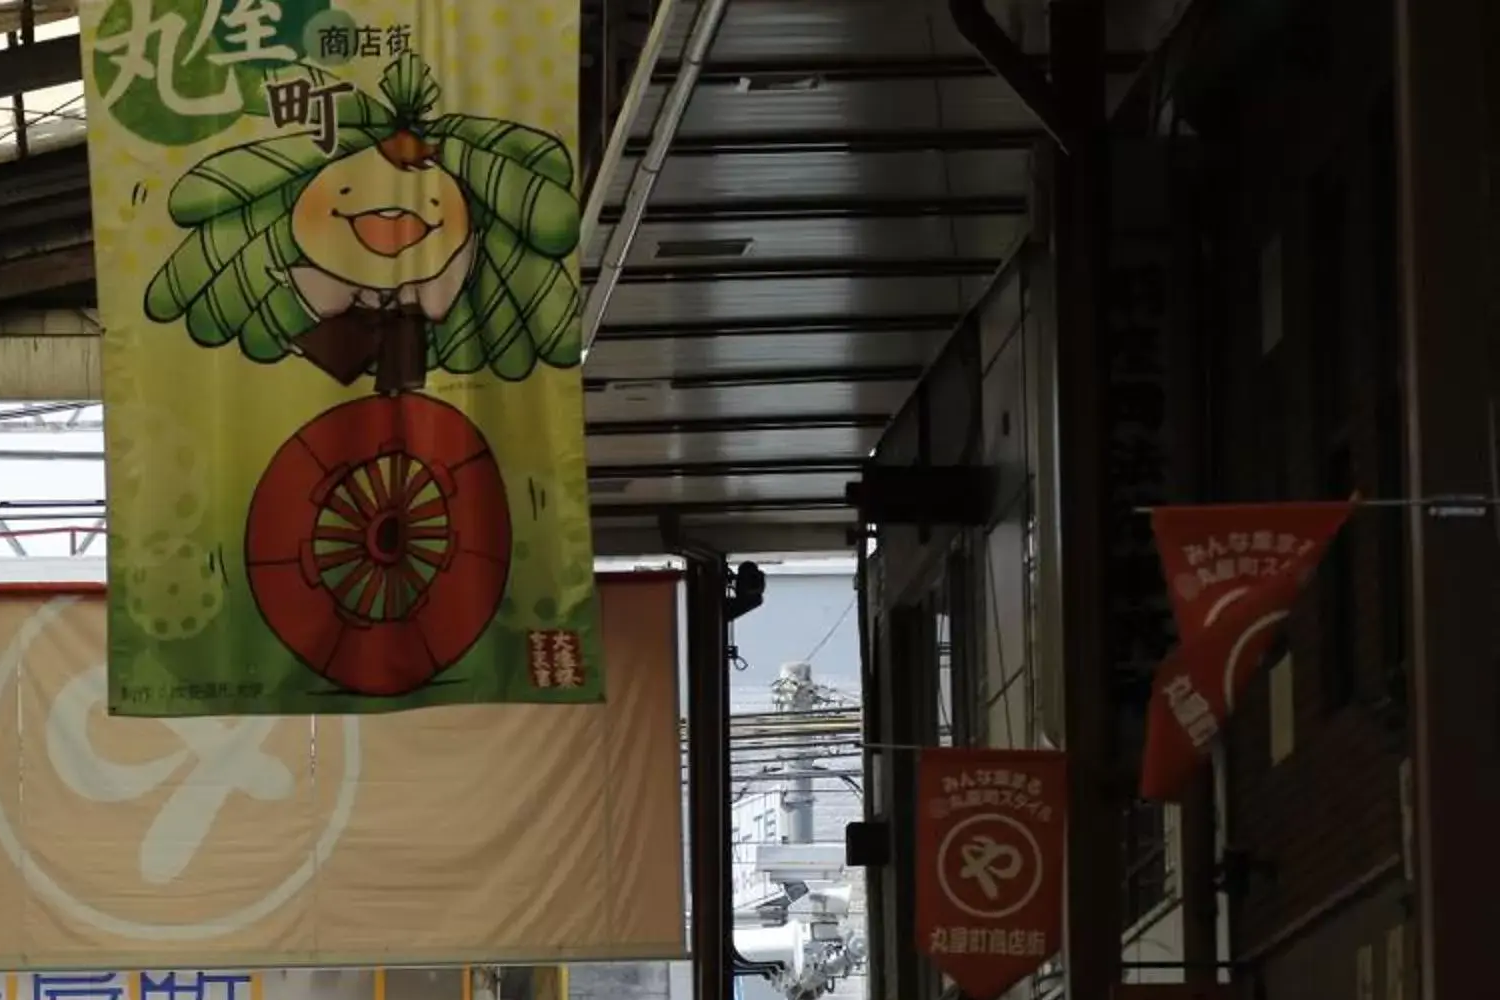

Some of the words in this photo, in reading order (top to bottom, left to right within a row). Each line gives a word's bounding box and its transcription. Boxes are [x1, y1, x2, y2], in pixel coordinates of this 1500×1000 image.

[319, 25, 413, 57] 商店街
[930, 926, 1047, 956] 丸屋町商店街
